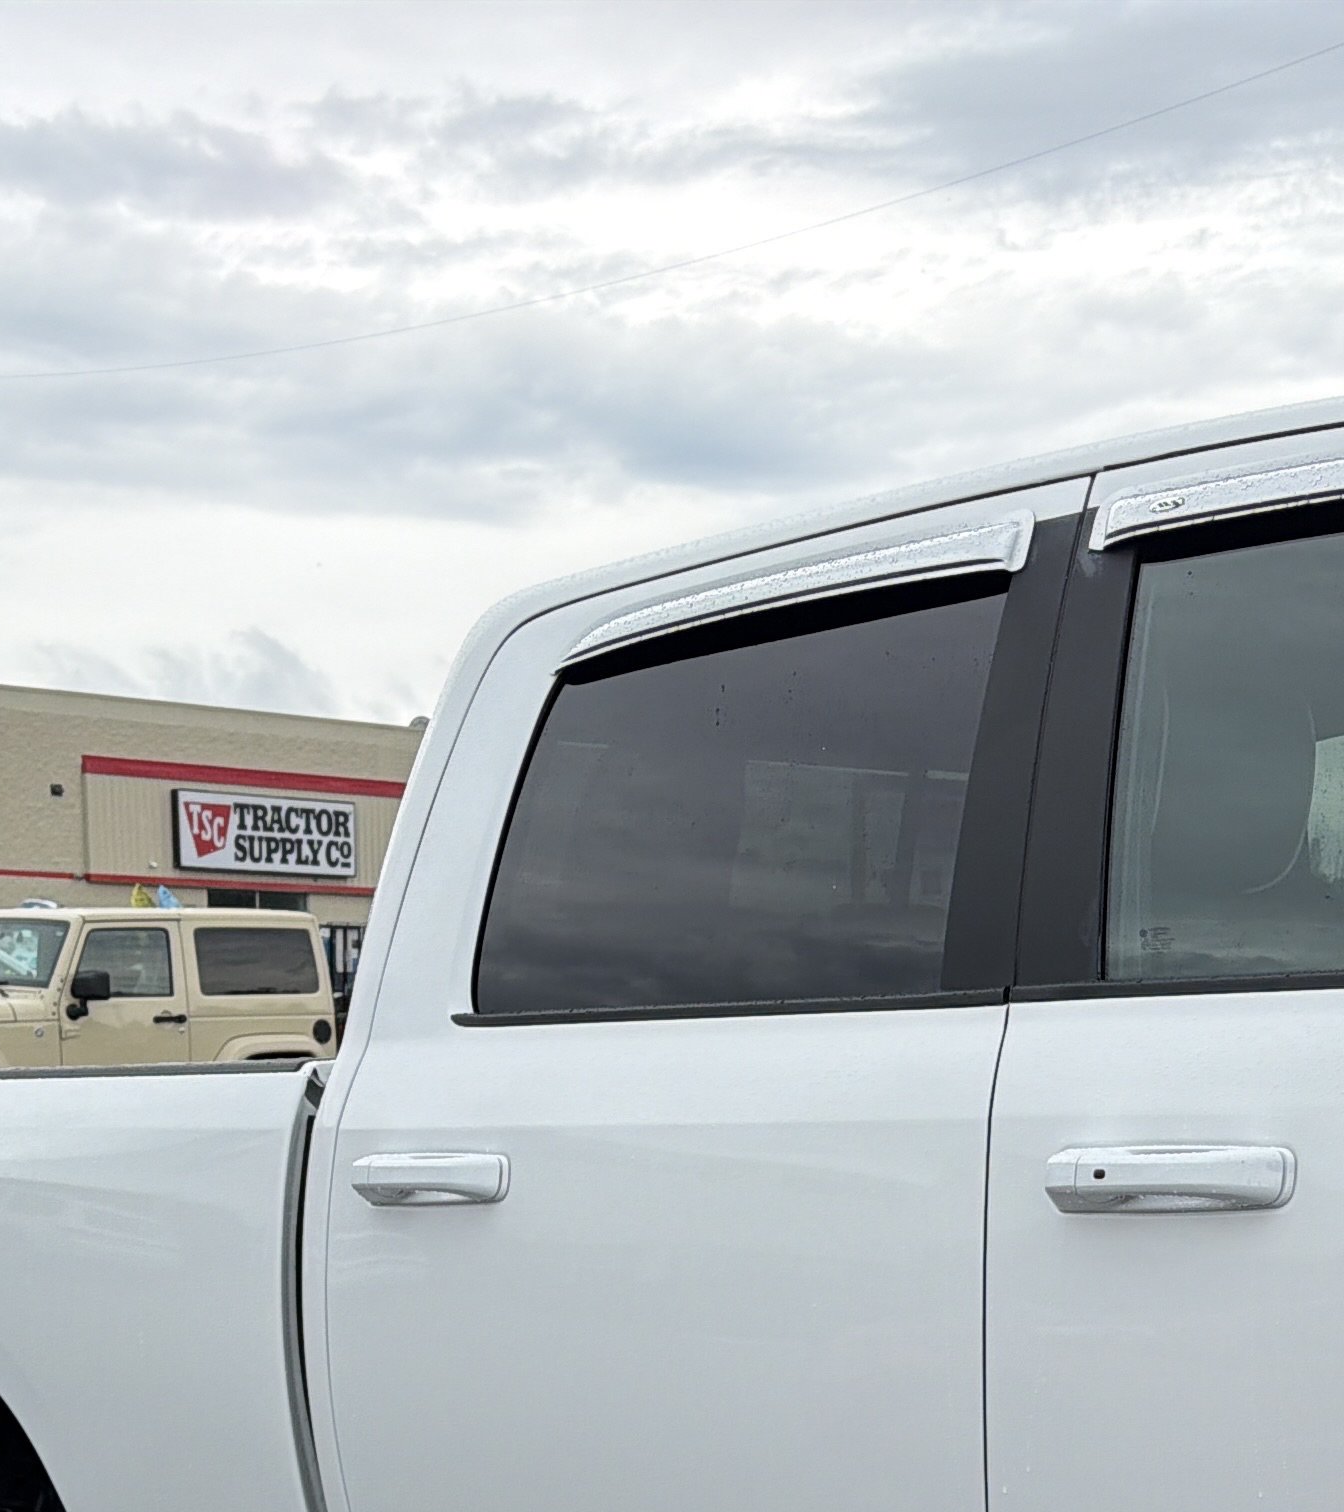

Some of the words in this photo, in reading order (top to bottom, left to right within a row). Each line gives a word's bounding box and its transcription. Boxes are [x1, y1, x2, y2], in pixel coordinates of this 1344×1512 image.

[189, 804, 225, 847] TSC
[233, 802, 351, 838] TRACTOR
[234, 834, 323, 866] SUPPLY
